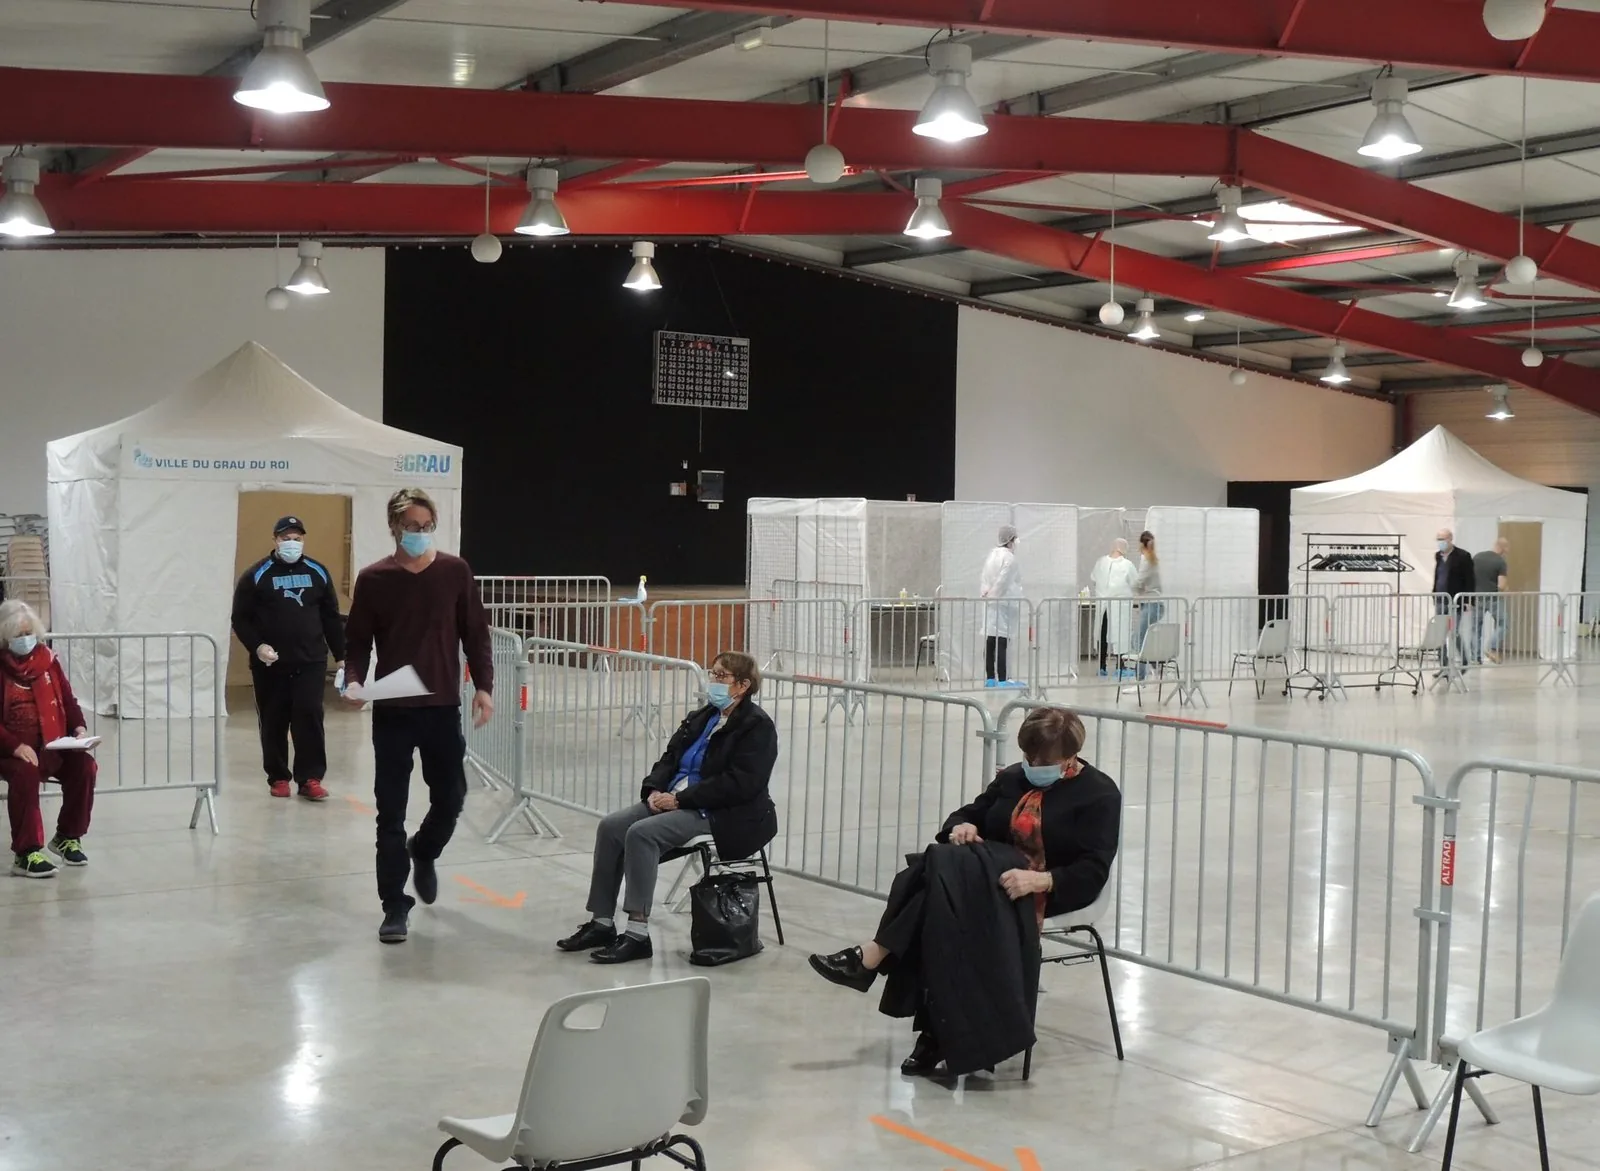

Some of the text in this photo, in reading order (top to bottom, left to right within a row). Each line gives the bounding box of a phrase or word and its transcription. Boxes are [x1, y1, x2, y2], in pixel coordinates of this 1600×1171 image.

[155, 458, 289, 470] VILLE DU GRAU DU ROI
[404, 454, 451, 473] GRAU
[1441, 841, 1451, 885] ALTRAD
